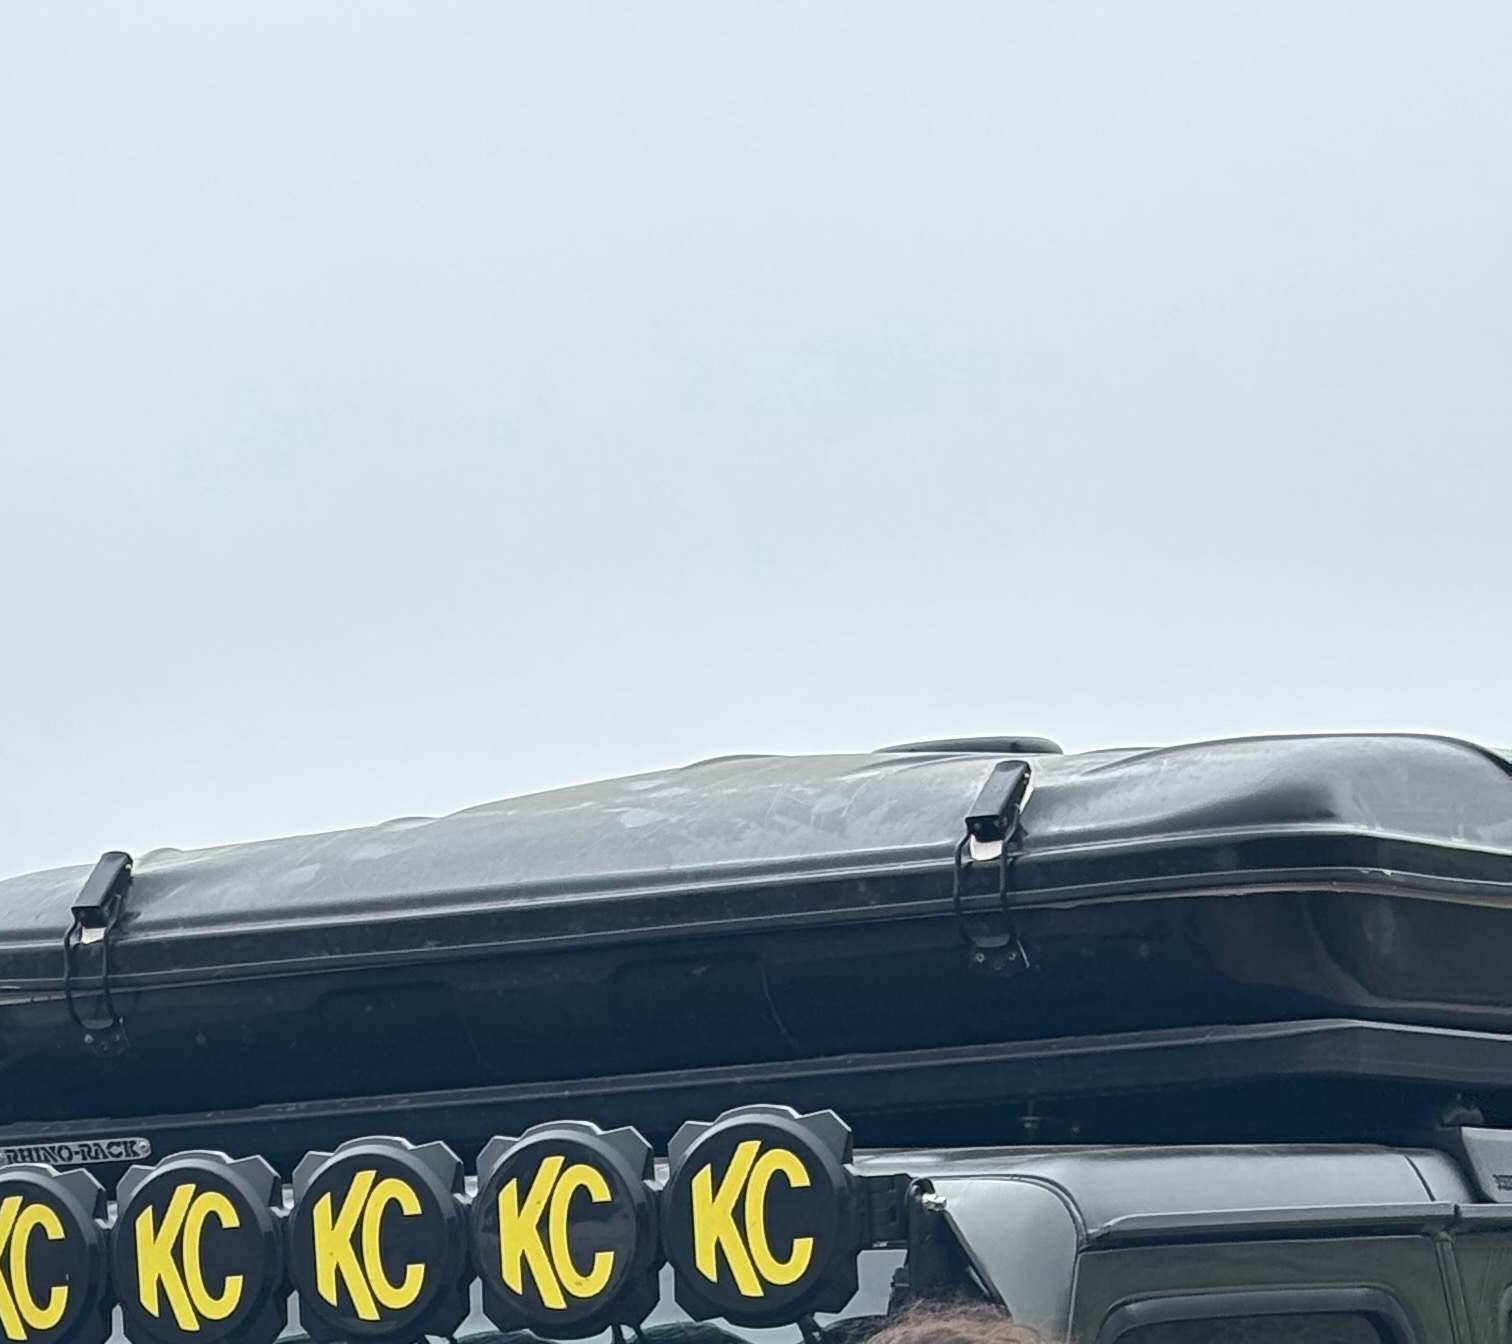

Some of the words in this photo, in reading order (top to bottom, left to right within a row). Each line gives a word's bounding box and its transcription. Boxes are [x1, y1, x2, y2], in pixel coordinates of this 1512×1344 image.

[5, 1140, 141, 1164] RHINO-RACK
[692, 1141, 813, 1297] KC
[135, 1183, 243, 1332] KC
[313, 1170, 425, 1320] KC
[498, 1156, 614, 1309] KC
